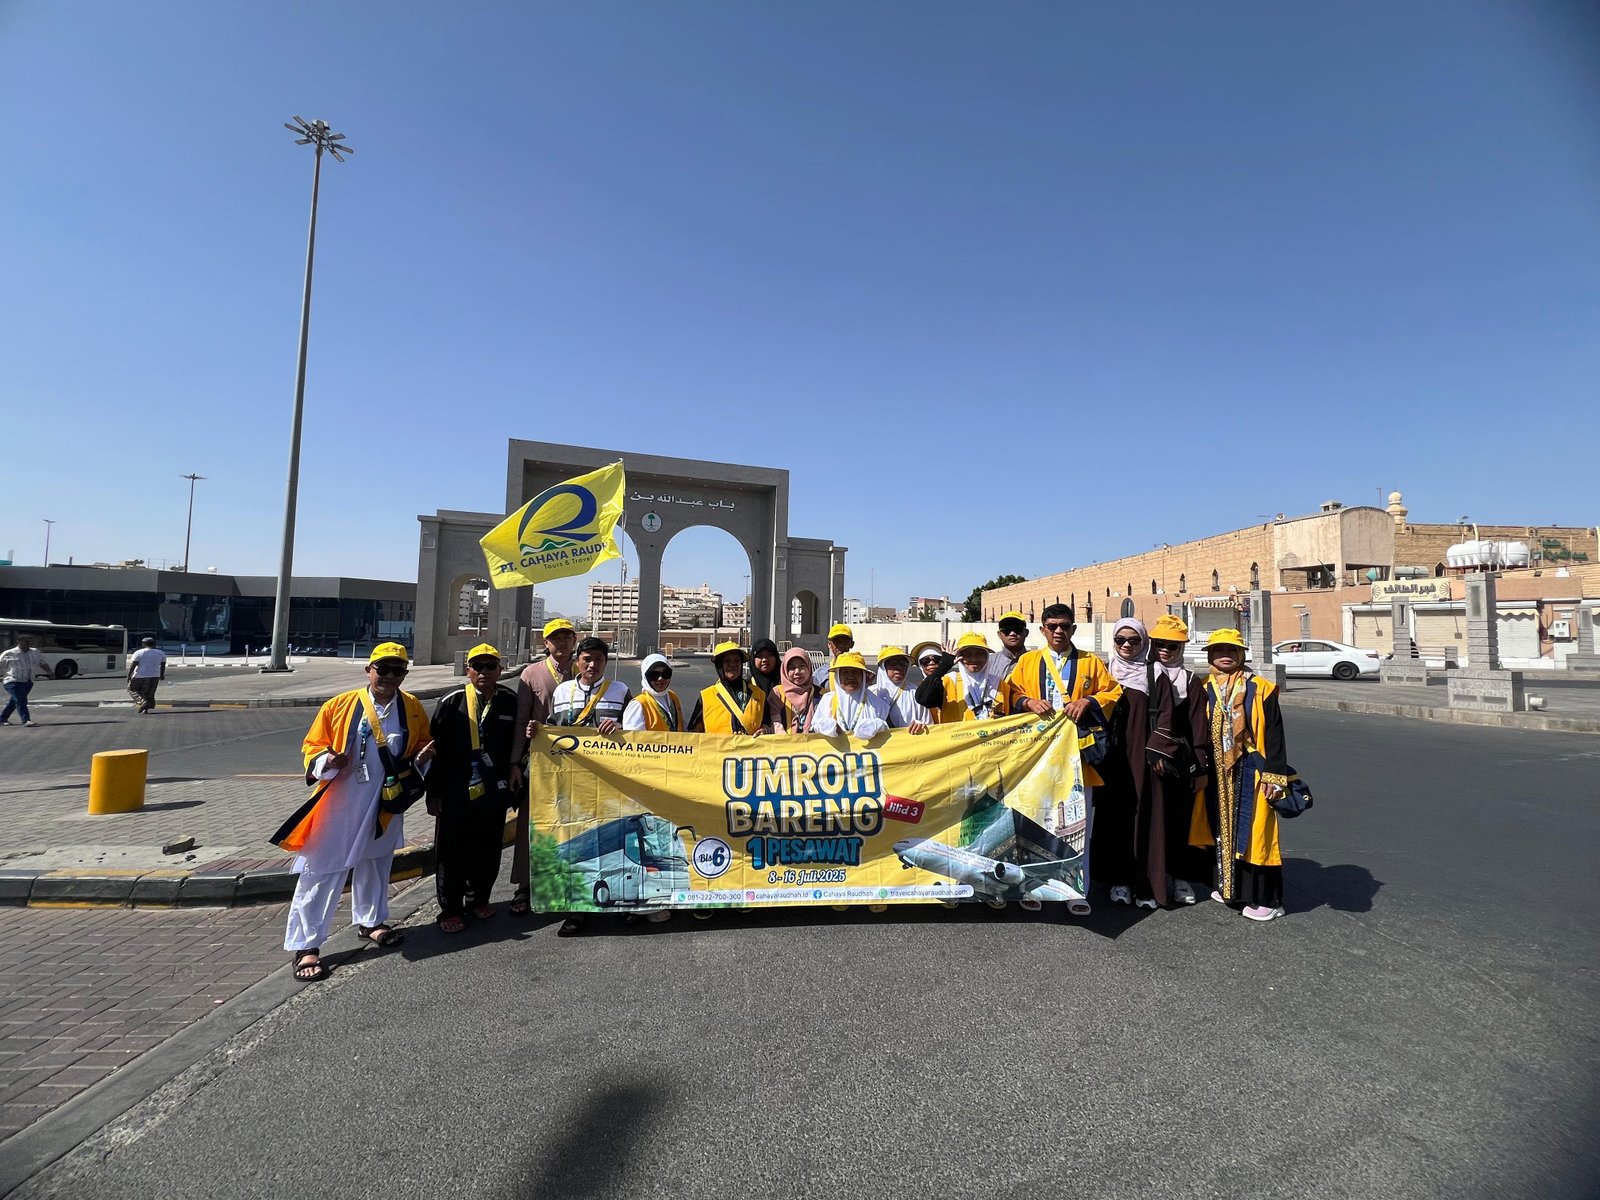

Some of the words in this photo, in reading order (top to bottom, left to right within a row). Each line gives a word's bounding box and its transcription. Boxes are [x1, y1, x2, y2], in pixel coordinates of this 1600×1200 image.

[630, 491, 655, 503] بن
[708, 499, 735, 512] باب
[500, 561, 518, 573] PT.
[520, 550, 569, 568] CAHAYA
[544, 561, 563, 570] Tours
[571, 555, 593, 564] Travel
[582, 740, 633, 751] CAHAYA
[636, 743, 693, 754] RAUDHAH
[724, 753, 880, 800] UMROH
[727, 797, 882, 836] BARENG
[886, 801, 910, 815] Jilid
[910, 807, 919, 817] 3
[712, 846, 725, 867] 6
[747, 837, 766, 869] 1
[766, 837, 863, 866] PESAWAT
[768, 870, 777, 884] 8
[784, 869, 796, 883] 16
[796, 869, 819, 886] Juli
[819, 869, 847, 882] 2025
[755, 891, 809, 900] cahayaraudhah.id
[823, 891, 846, 899] Cahaya
[890, 889, 969, 898] travelcahayaraudhah.com
